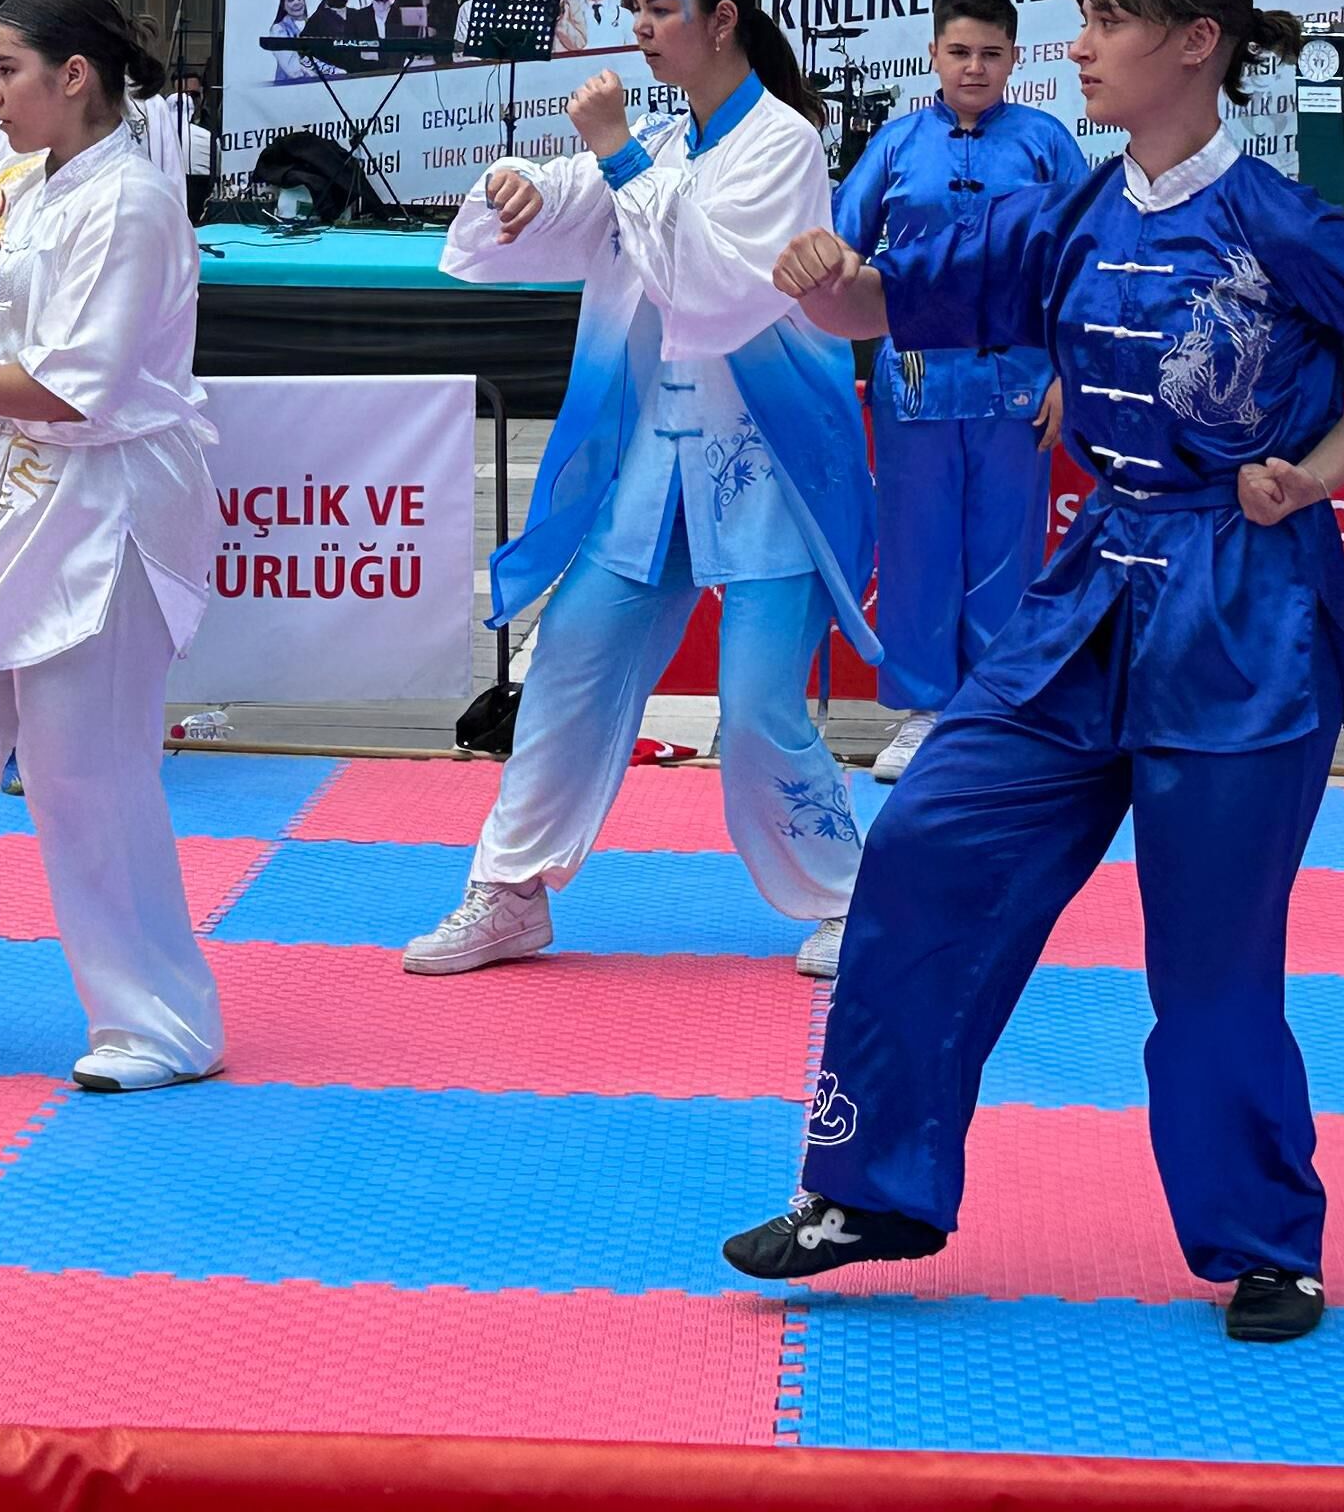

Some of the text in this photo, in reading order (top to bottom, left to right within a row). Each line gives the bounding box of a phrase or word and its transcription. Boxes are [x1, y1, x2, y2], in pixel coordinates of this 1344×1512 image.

[421, 101, 495, 132] GENÇLİK
[215, 473, 351, 538] NÇLİK
[364, 485, 426, 527] VE
[209, 541, 422, 600] ÜRLÜĞÜ
